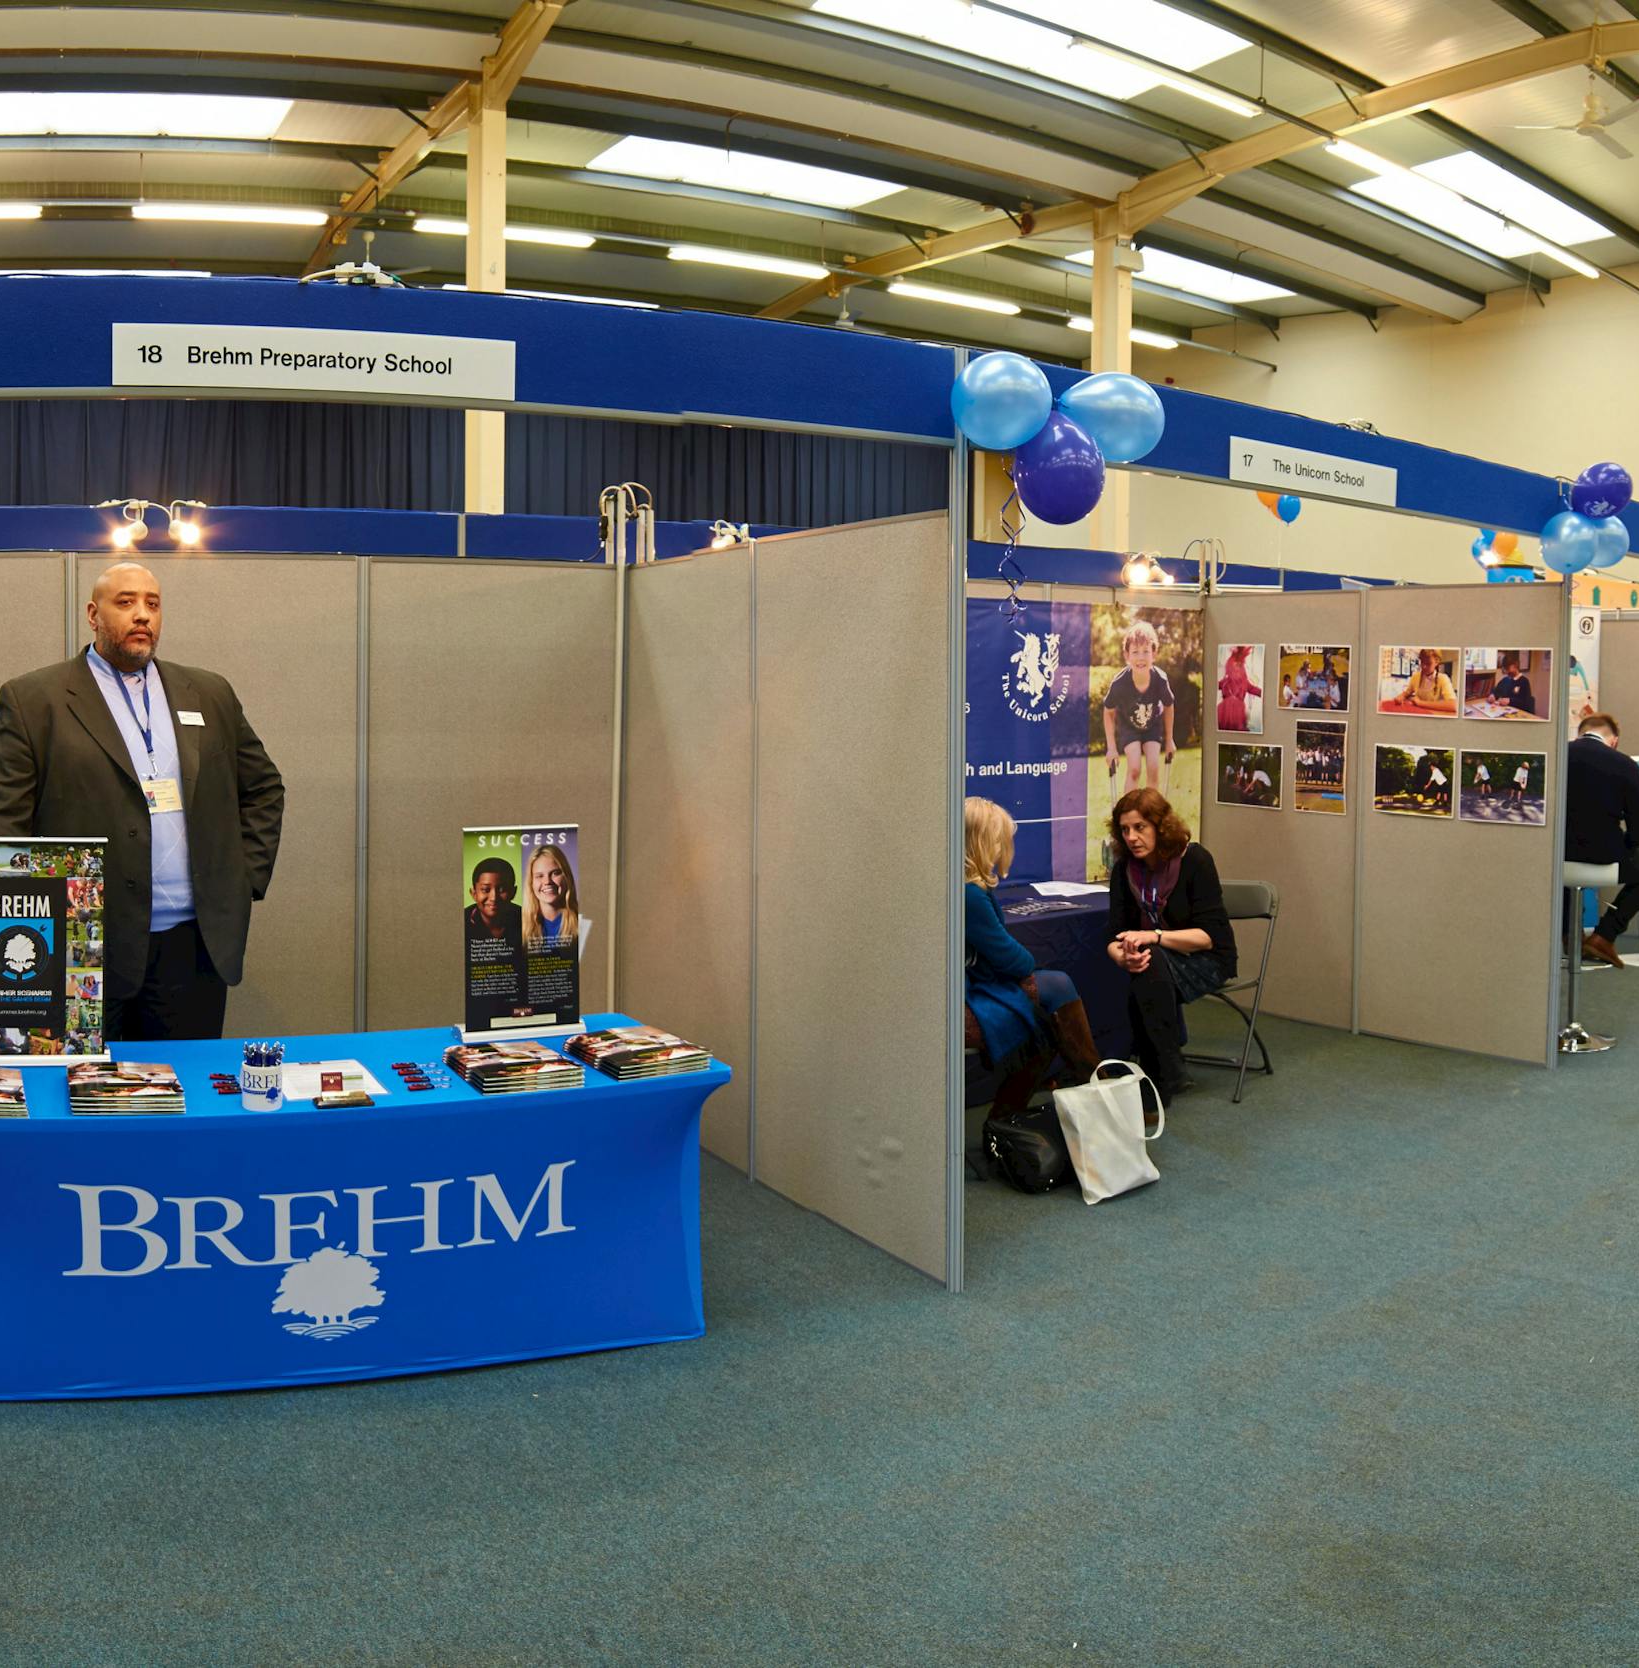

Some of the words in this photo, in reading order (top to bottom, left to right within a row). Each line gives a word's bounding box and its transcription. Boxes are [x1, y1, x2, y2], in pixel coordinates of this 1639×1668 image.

[137, 345, 163, 364] 18
[187, 345, 253, 366] Brehm
[260, 347, 377, 374] Preparatory
[384, 354, 453, 375] School
[1243, 454, 1253, 467] 17
[1273, 459, 1291, 474] The
[1295, 463, 1331, 481] Unicorn
[1334, 470, 1365, 487] School
[1001, 673, 1011, 698] The
[1008, 700, 1049, 722] Unicorn
[1050, 674, 1071, 714] School
[979, 762, 1003, 776] and
[1007, 760, 1068, 776] Language
[477, 832, 567, 848] SUCCESS
[58, 1159, 577, 1279] BREHM
